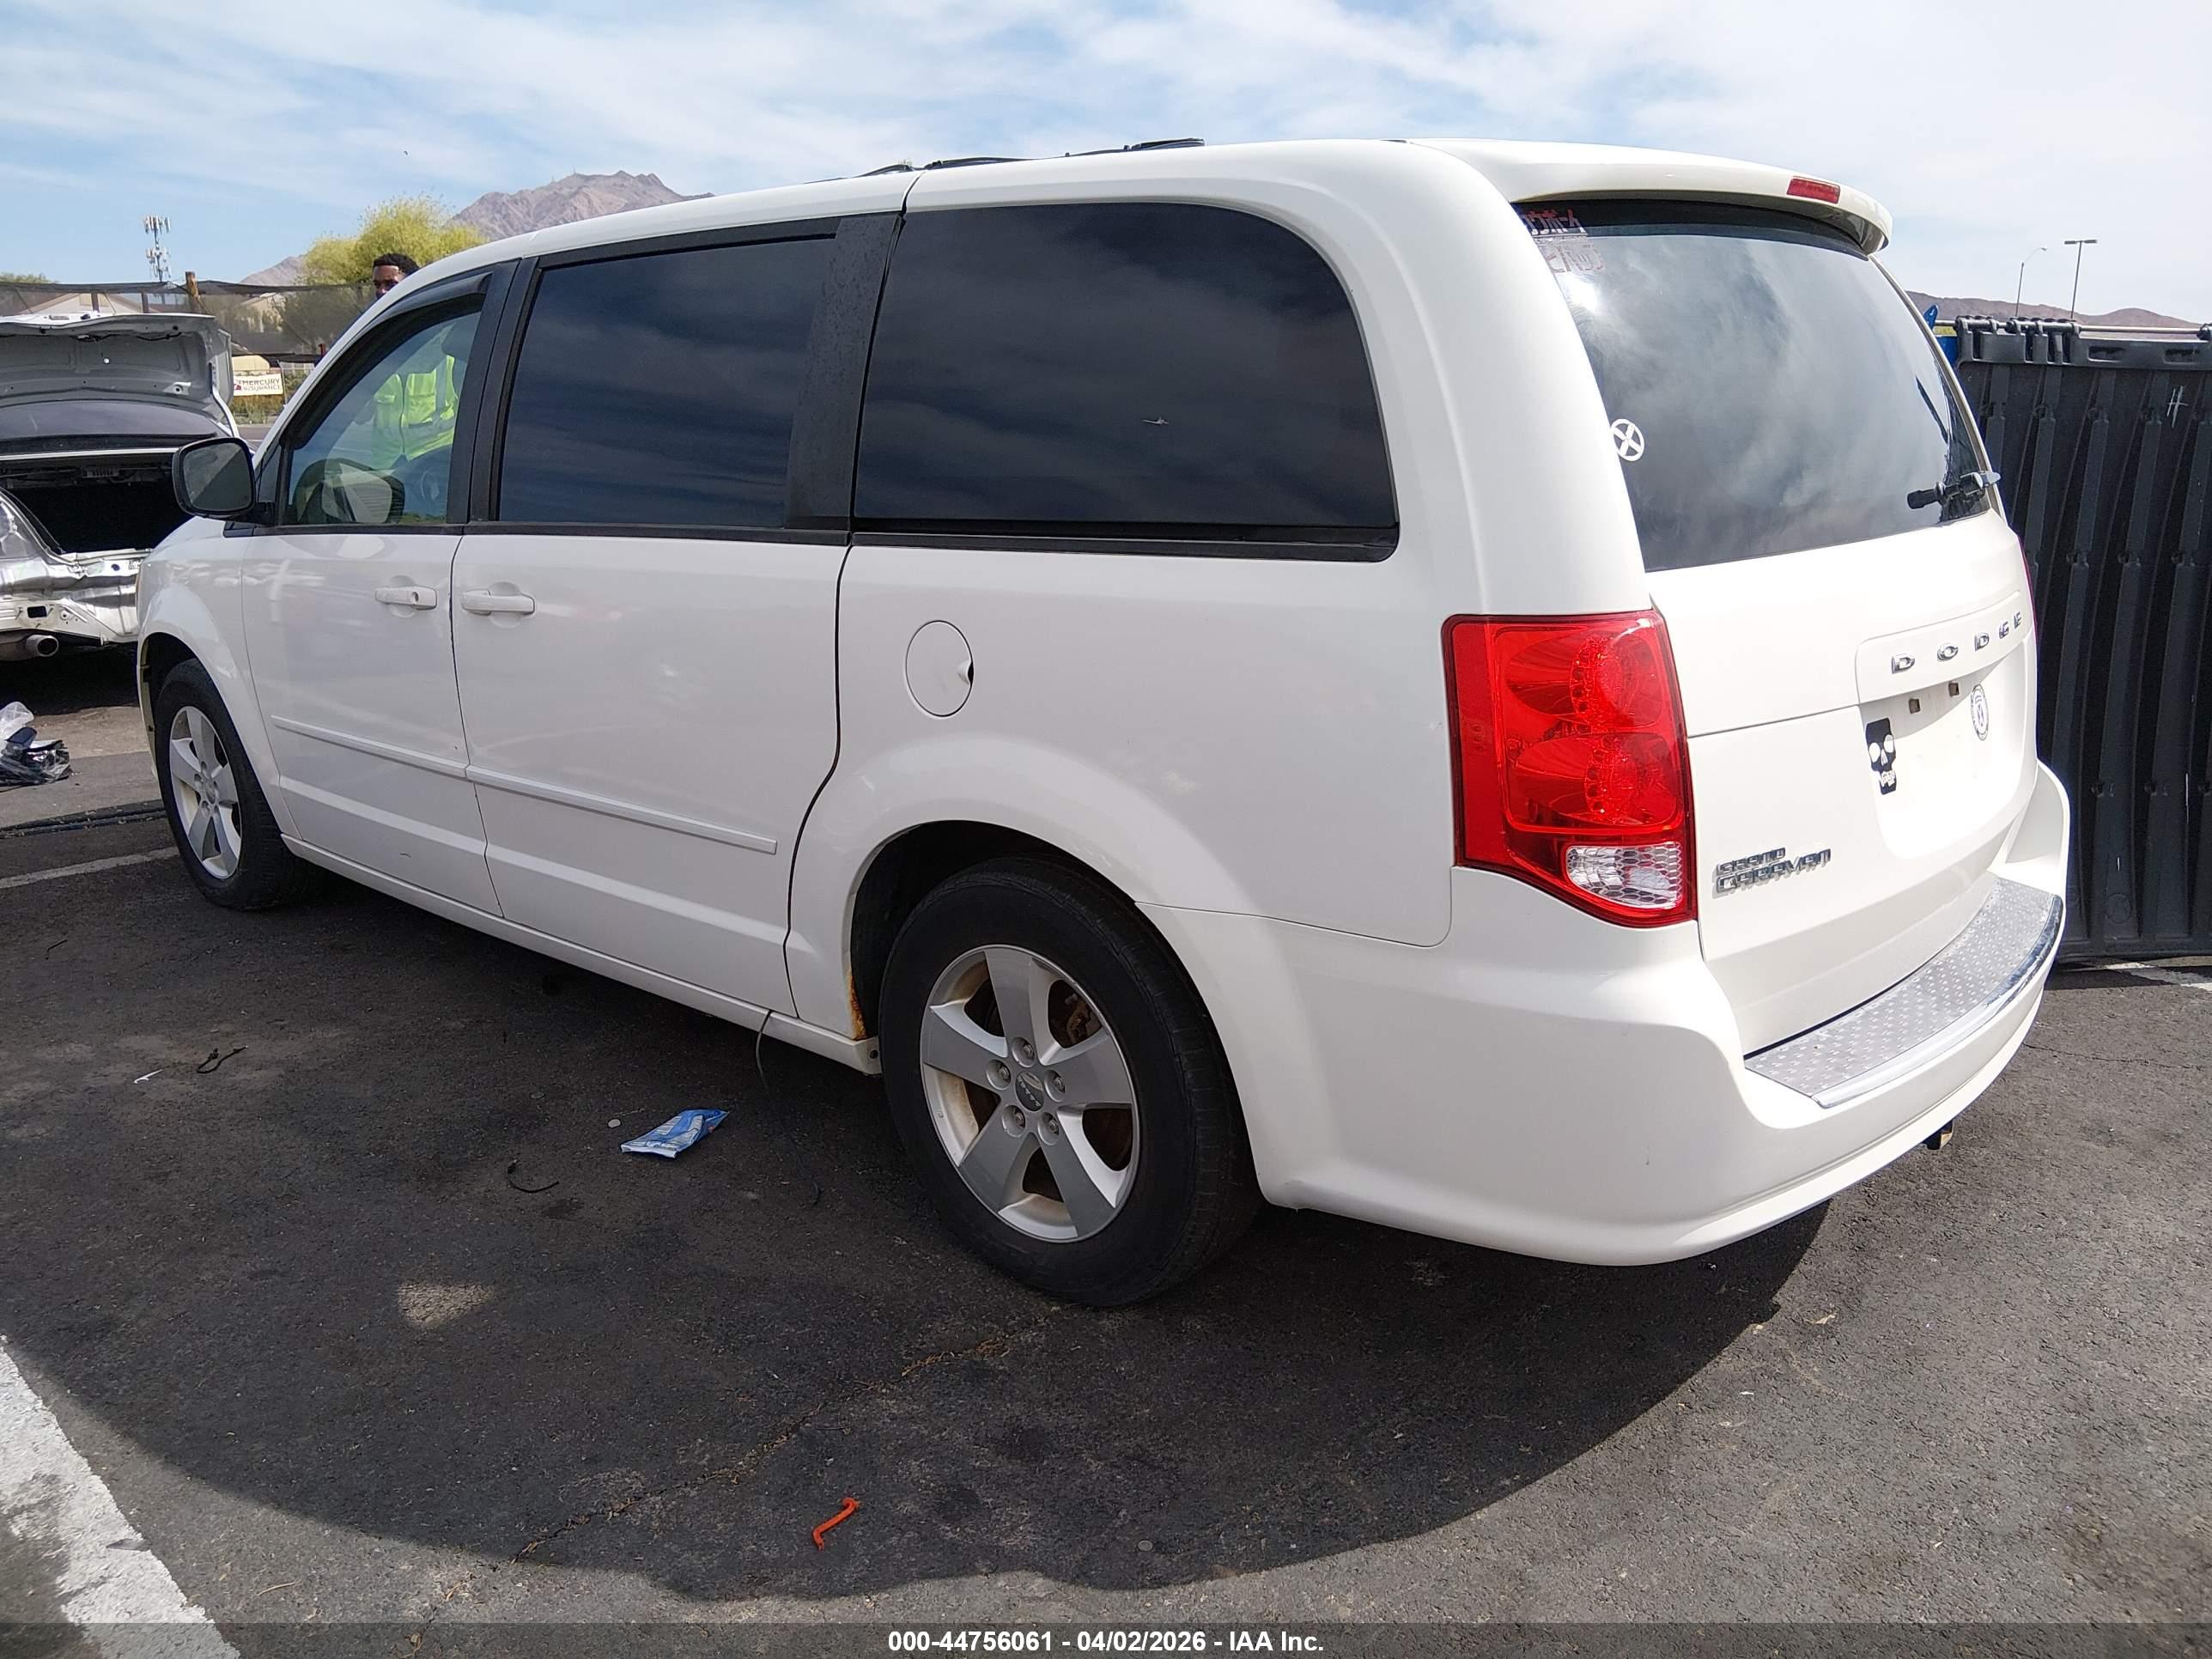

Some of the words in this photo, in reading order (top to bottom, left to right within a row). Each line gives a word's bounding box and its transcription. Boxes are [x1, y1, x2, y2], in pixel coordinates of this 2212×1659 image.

[1891, 611, 2022, 674] DODGE
[1716, 848, 1786, 875] GRAND
[1716, 848, 1832, 893] CARAVAN
